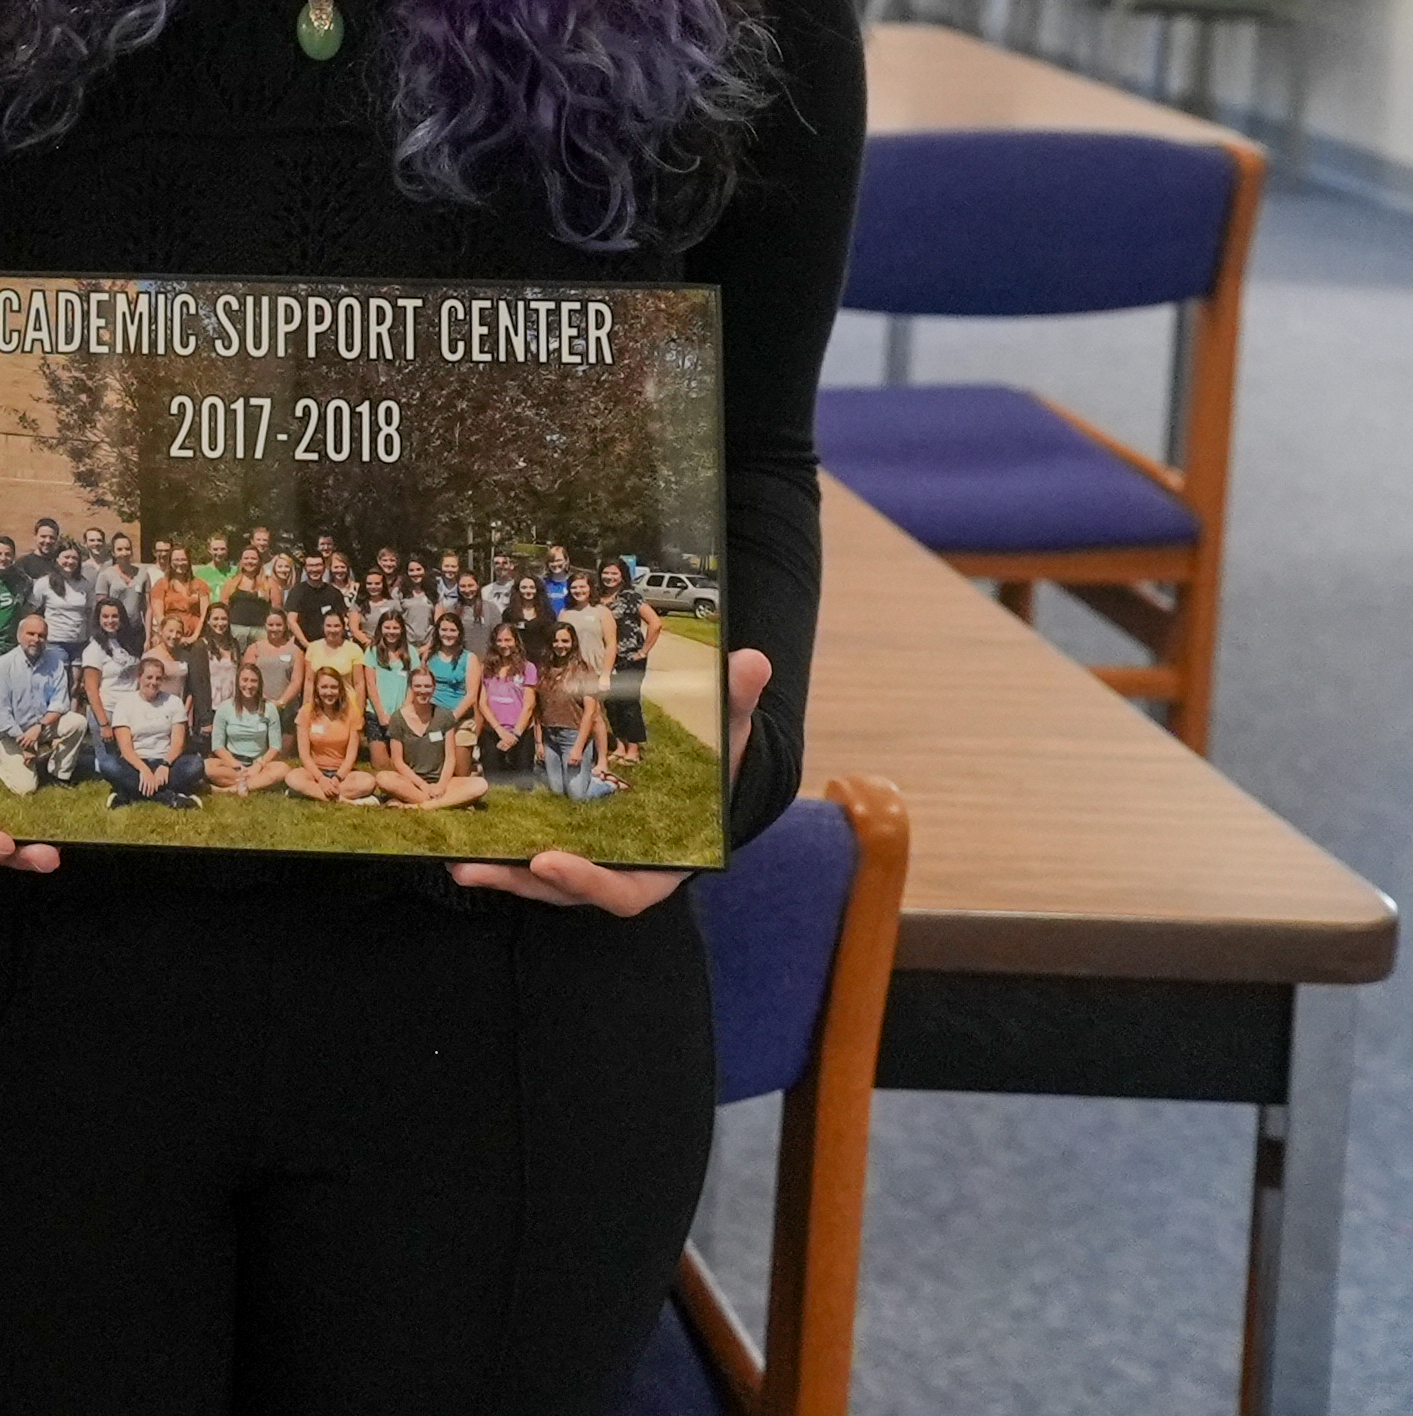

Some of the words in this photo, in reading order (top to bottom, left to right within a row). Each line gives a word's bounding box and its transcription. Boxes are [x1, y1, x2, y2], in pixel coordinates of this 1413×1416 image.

[214, 293, 424, 361] SUPPORT
[440, 297, 615, 365] CENTER
[169, 394, 402, 464] 2017-2018
